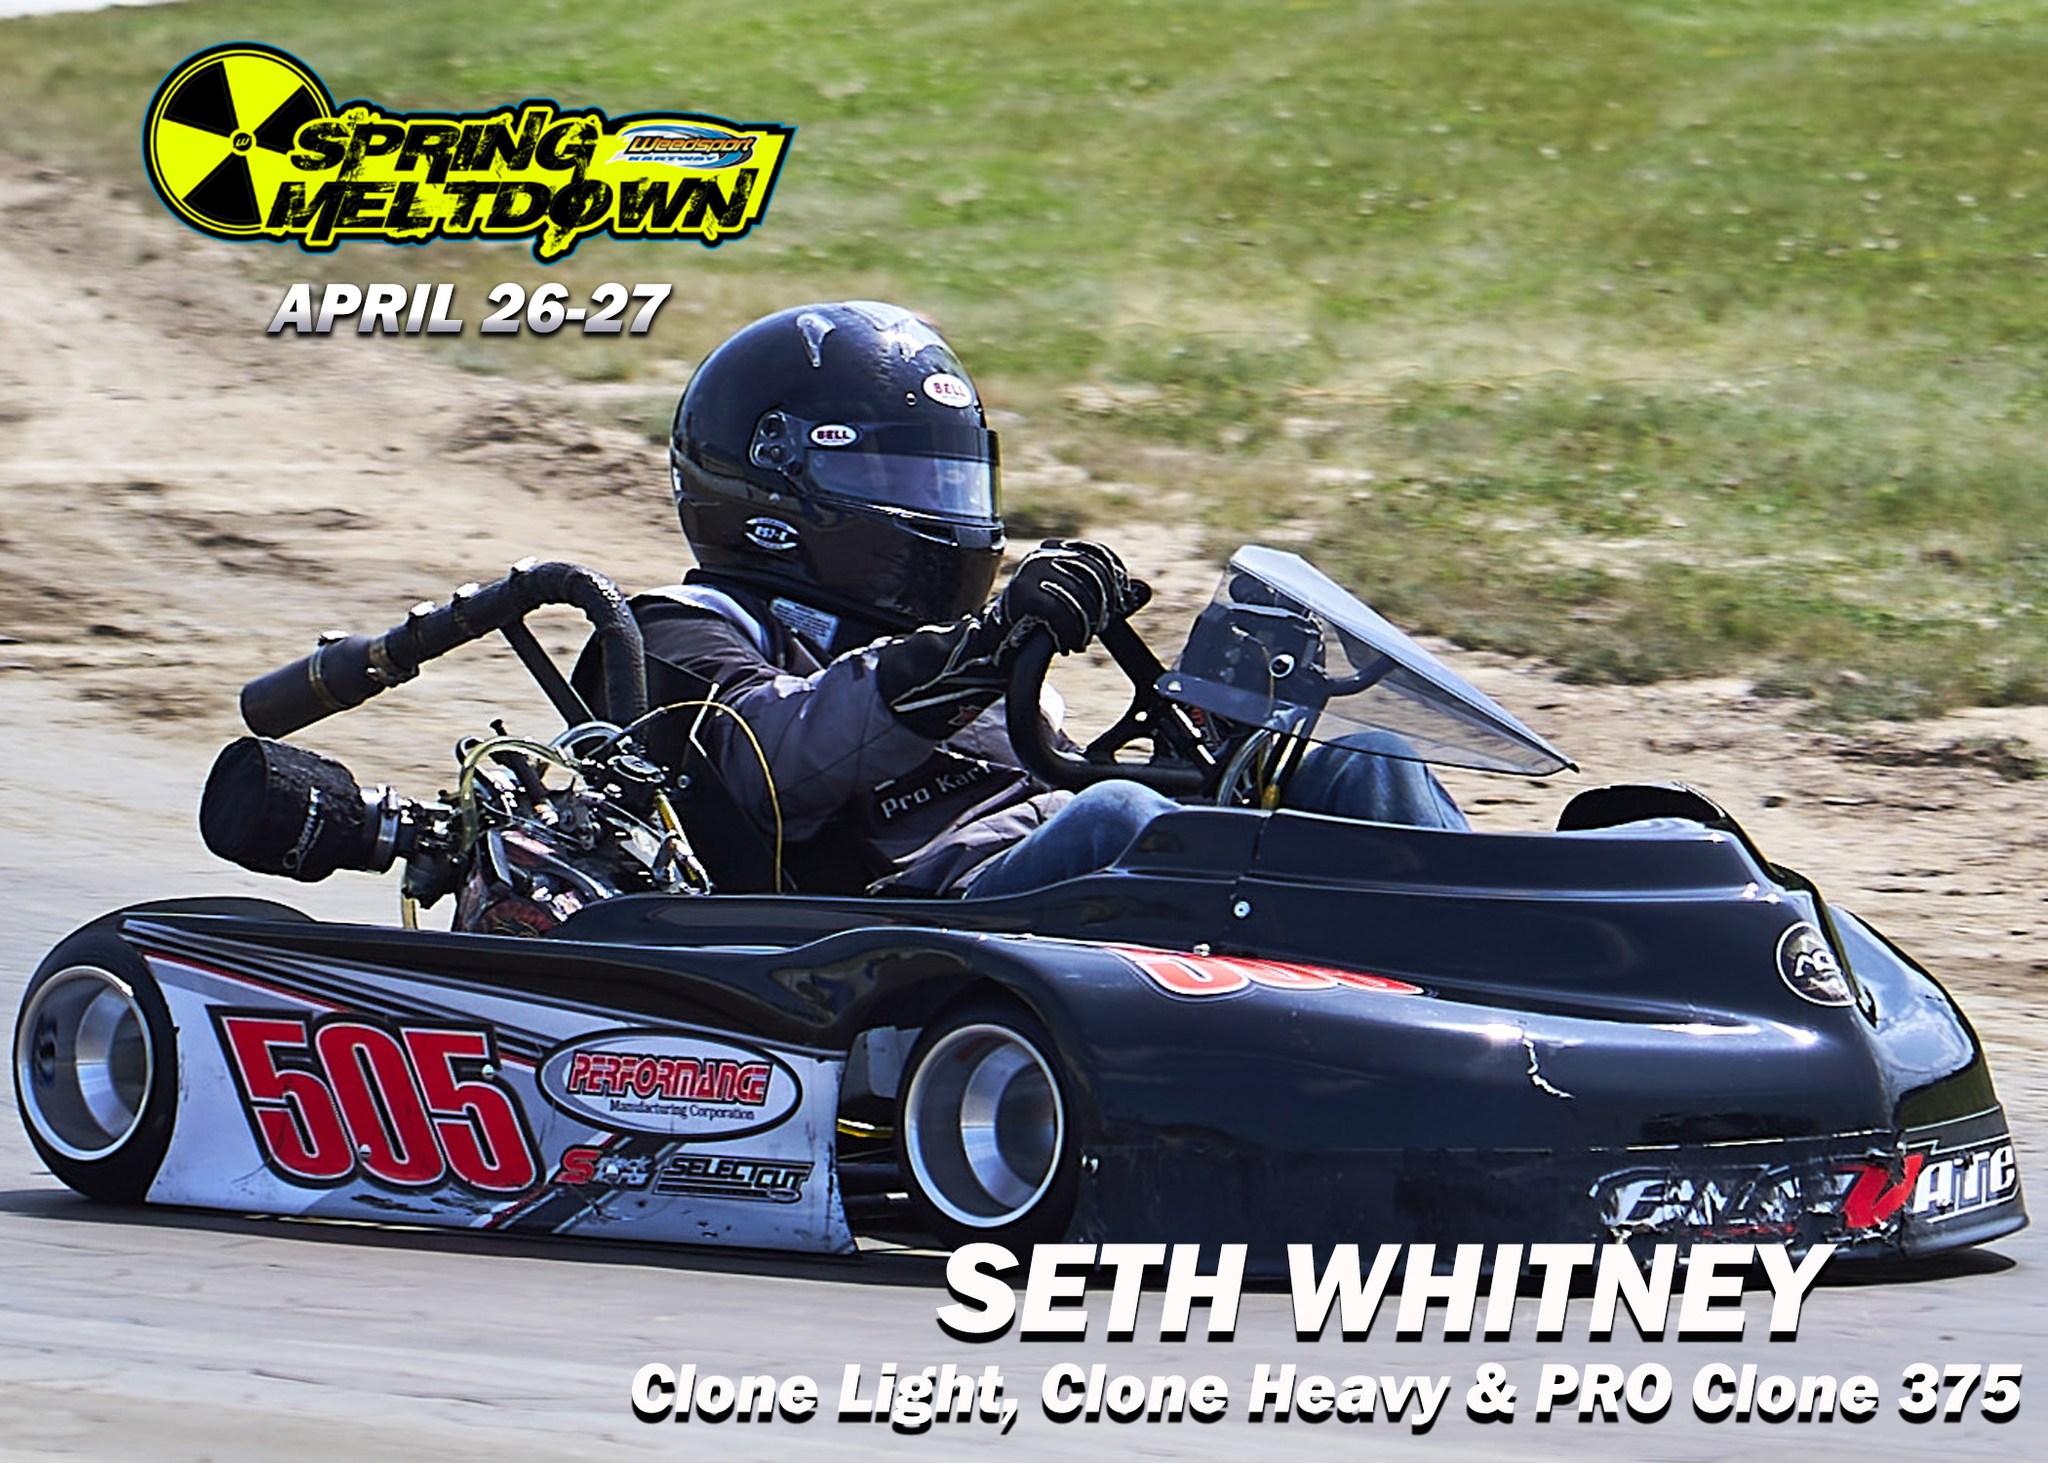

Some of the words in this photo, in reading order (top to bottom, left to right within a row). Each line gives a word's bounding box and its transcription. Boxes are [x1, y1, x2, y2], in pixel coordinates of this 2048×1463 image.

[816, 430, 851, 440] BELL
[568, 1052, 773, 1104] PERFORMANCE
[215, 1010, 538, 1195] 505
[609, 1100, 688, 1119] Manufacturing
[691, 1104, 755, 1121] Corporation
